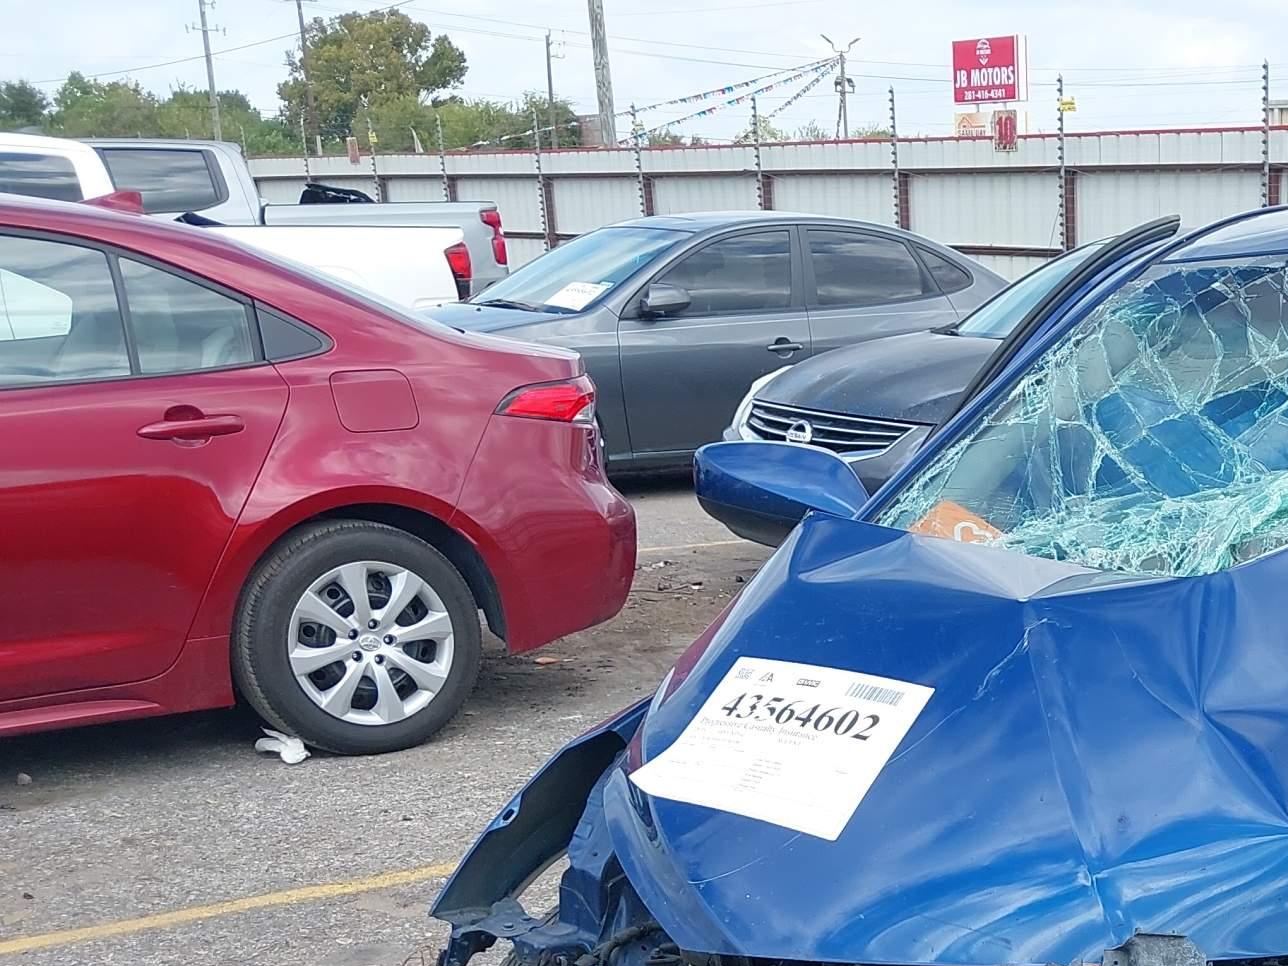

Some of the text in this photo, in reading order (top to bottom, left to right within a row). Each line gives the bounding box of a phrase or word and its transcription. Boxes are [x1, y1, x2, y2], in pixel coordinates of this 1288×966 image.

[955, 66, 1014, 88] JB MOTORS
[964, 88, 1006, 101] 281-416-4341
[721, 692, 881, 741] 43564602
